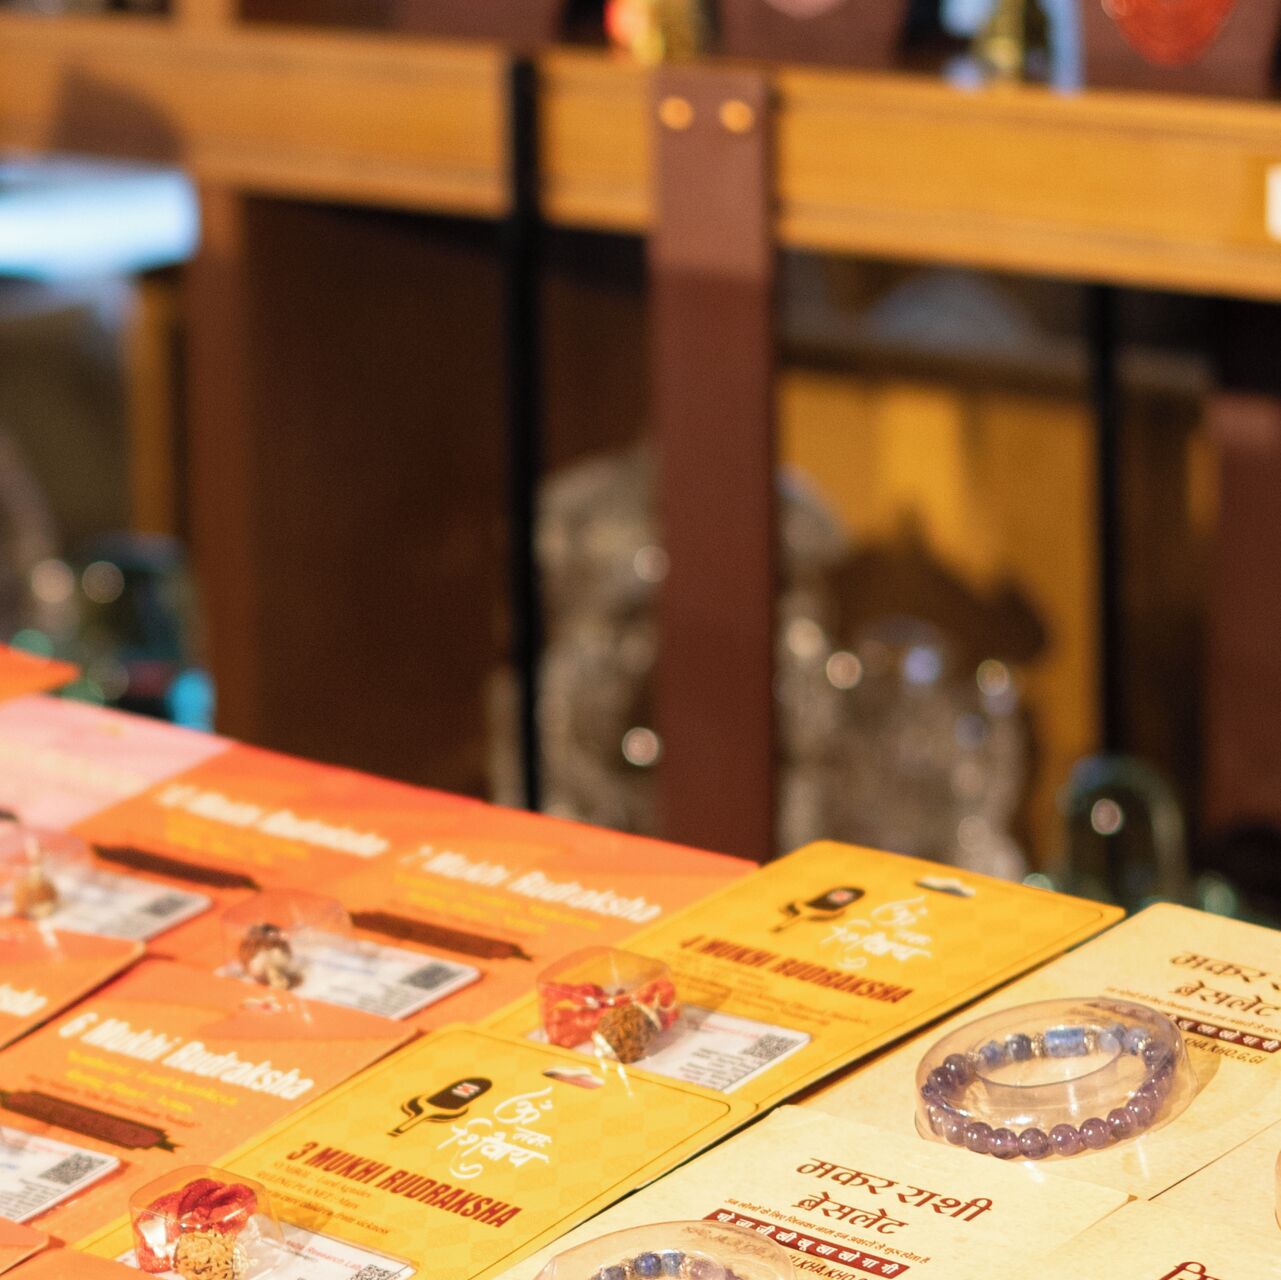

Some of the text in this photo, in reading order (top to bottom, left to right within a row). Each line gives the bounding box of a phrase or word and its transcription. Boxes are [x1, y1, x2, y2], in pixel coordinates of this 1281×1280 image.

[772, 958, 914, 1003] RUDRAKSHA
[162, 1041, 314, 1100] Rudraksha
[286, 1141, 522, 1228] 3 MUKHI RUDRAKSHA
[790, 1191, 909, 1235] ब्रेसलेट
[796, 1157, 993, 1222] मकर राशी
